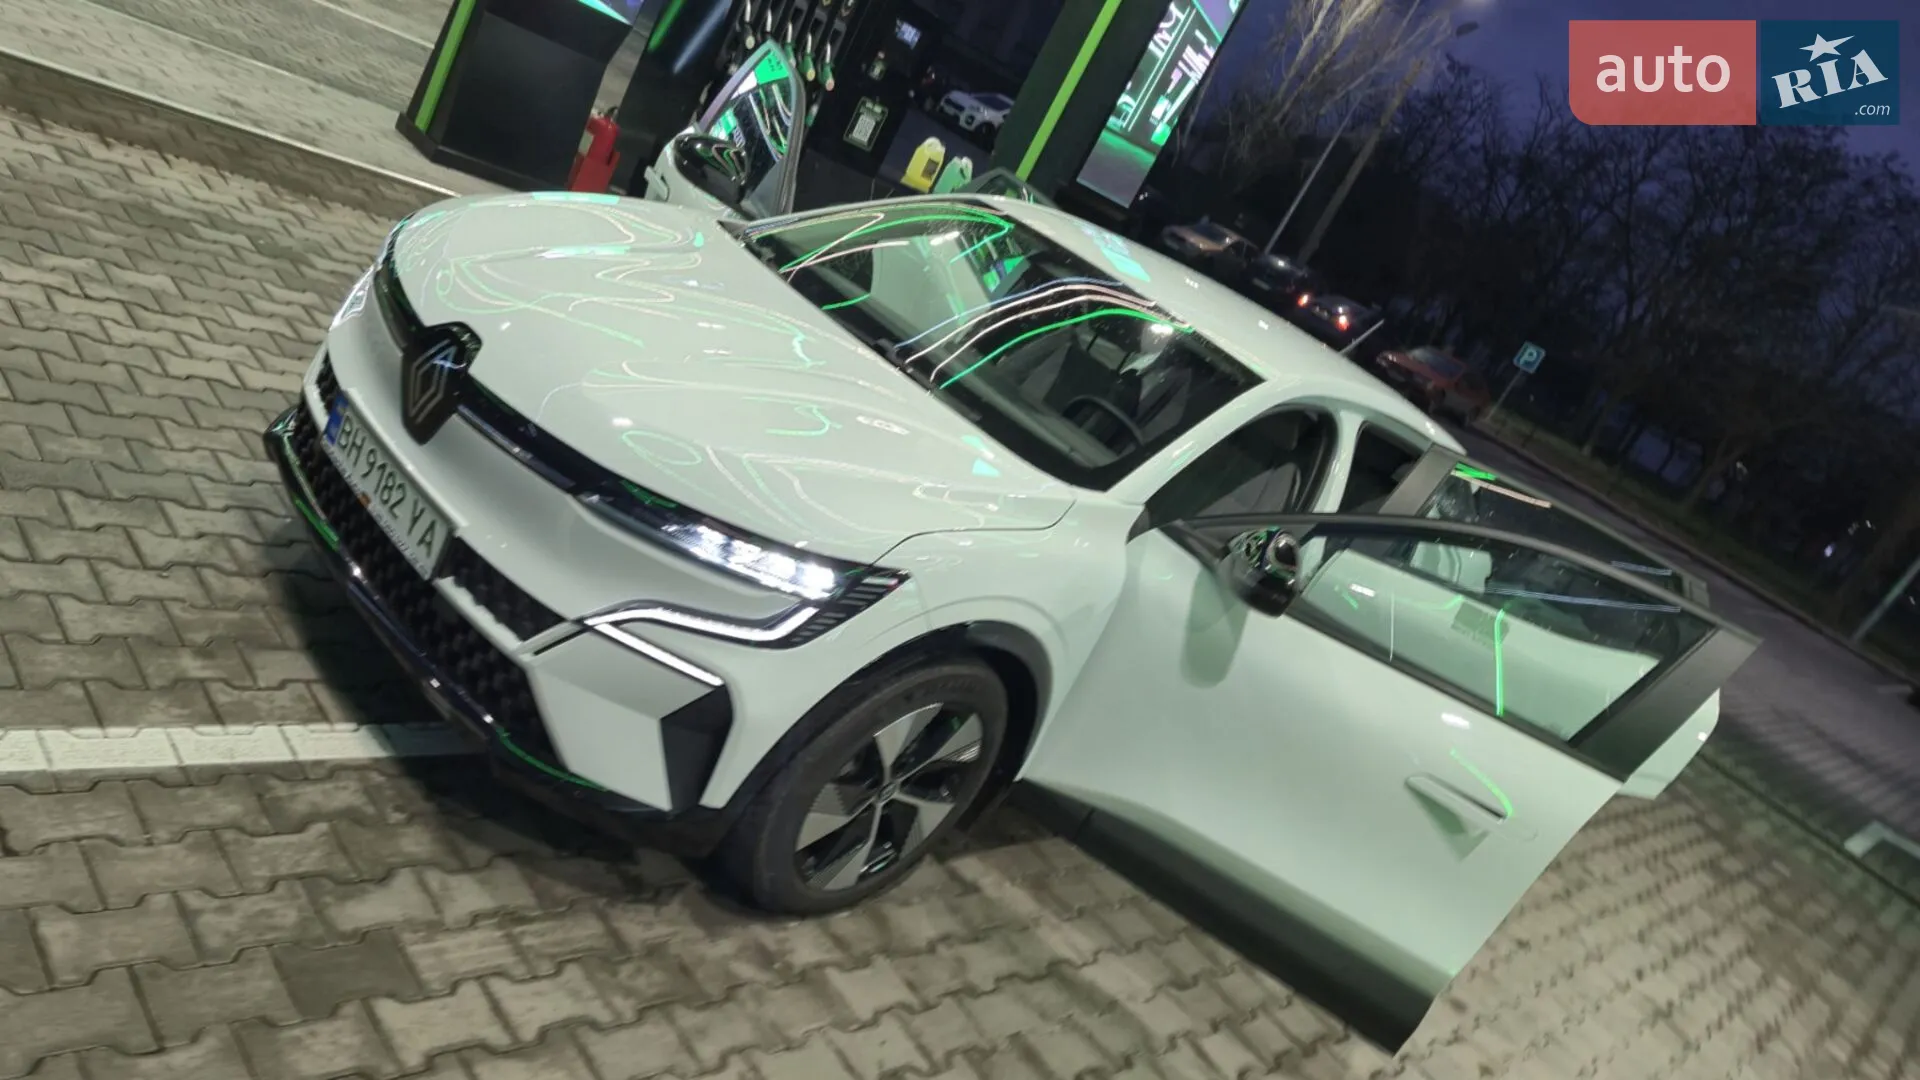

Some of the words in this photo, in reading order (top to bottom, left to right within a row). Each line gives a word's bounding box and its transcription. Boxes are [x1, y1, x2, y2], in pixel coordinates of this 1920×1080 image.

[1519, 346, 1538, 365] P
[337, 415, 367, 467] BH
[361, 448, 408, 520] 9182
[407, 498, 438, 559] YA
